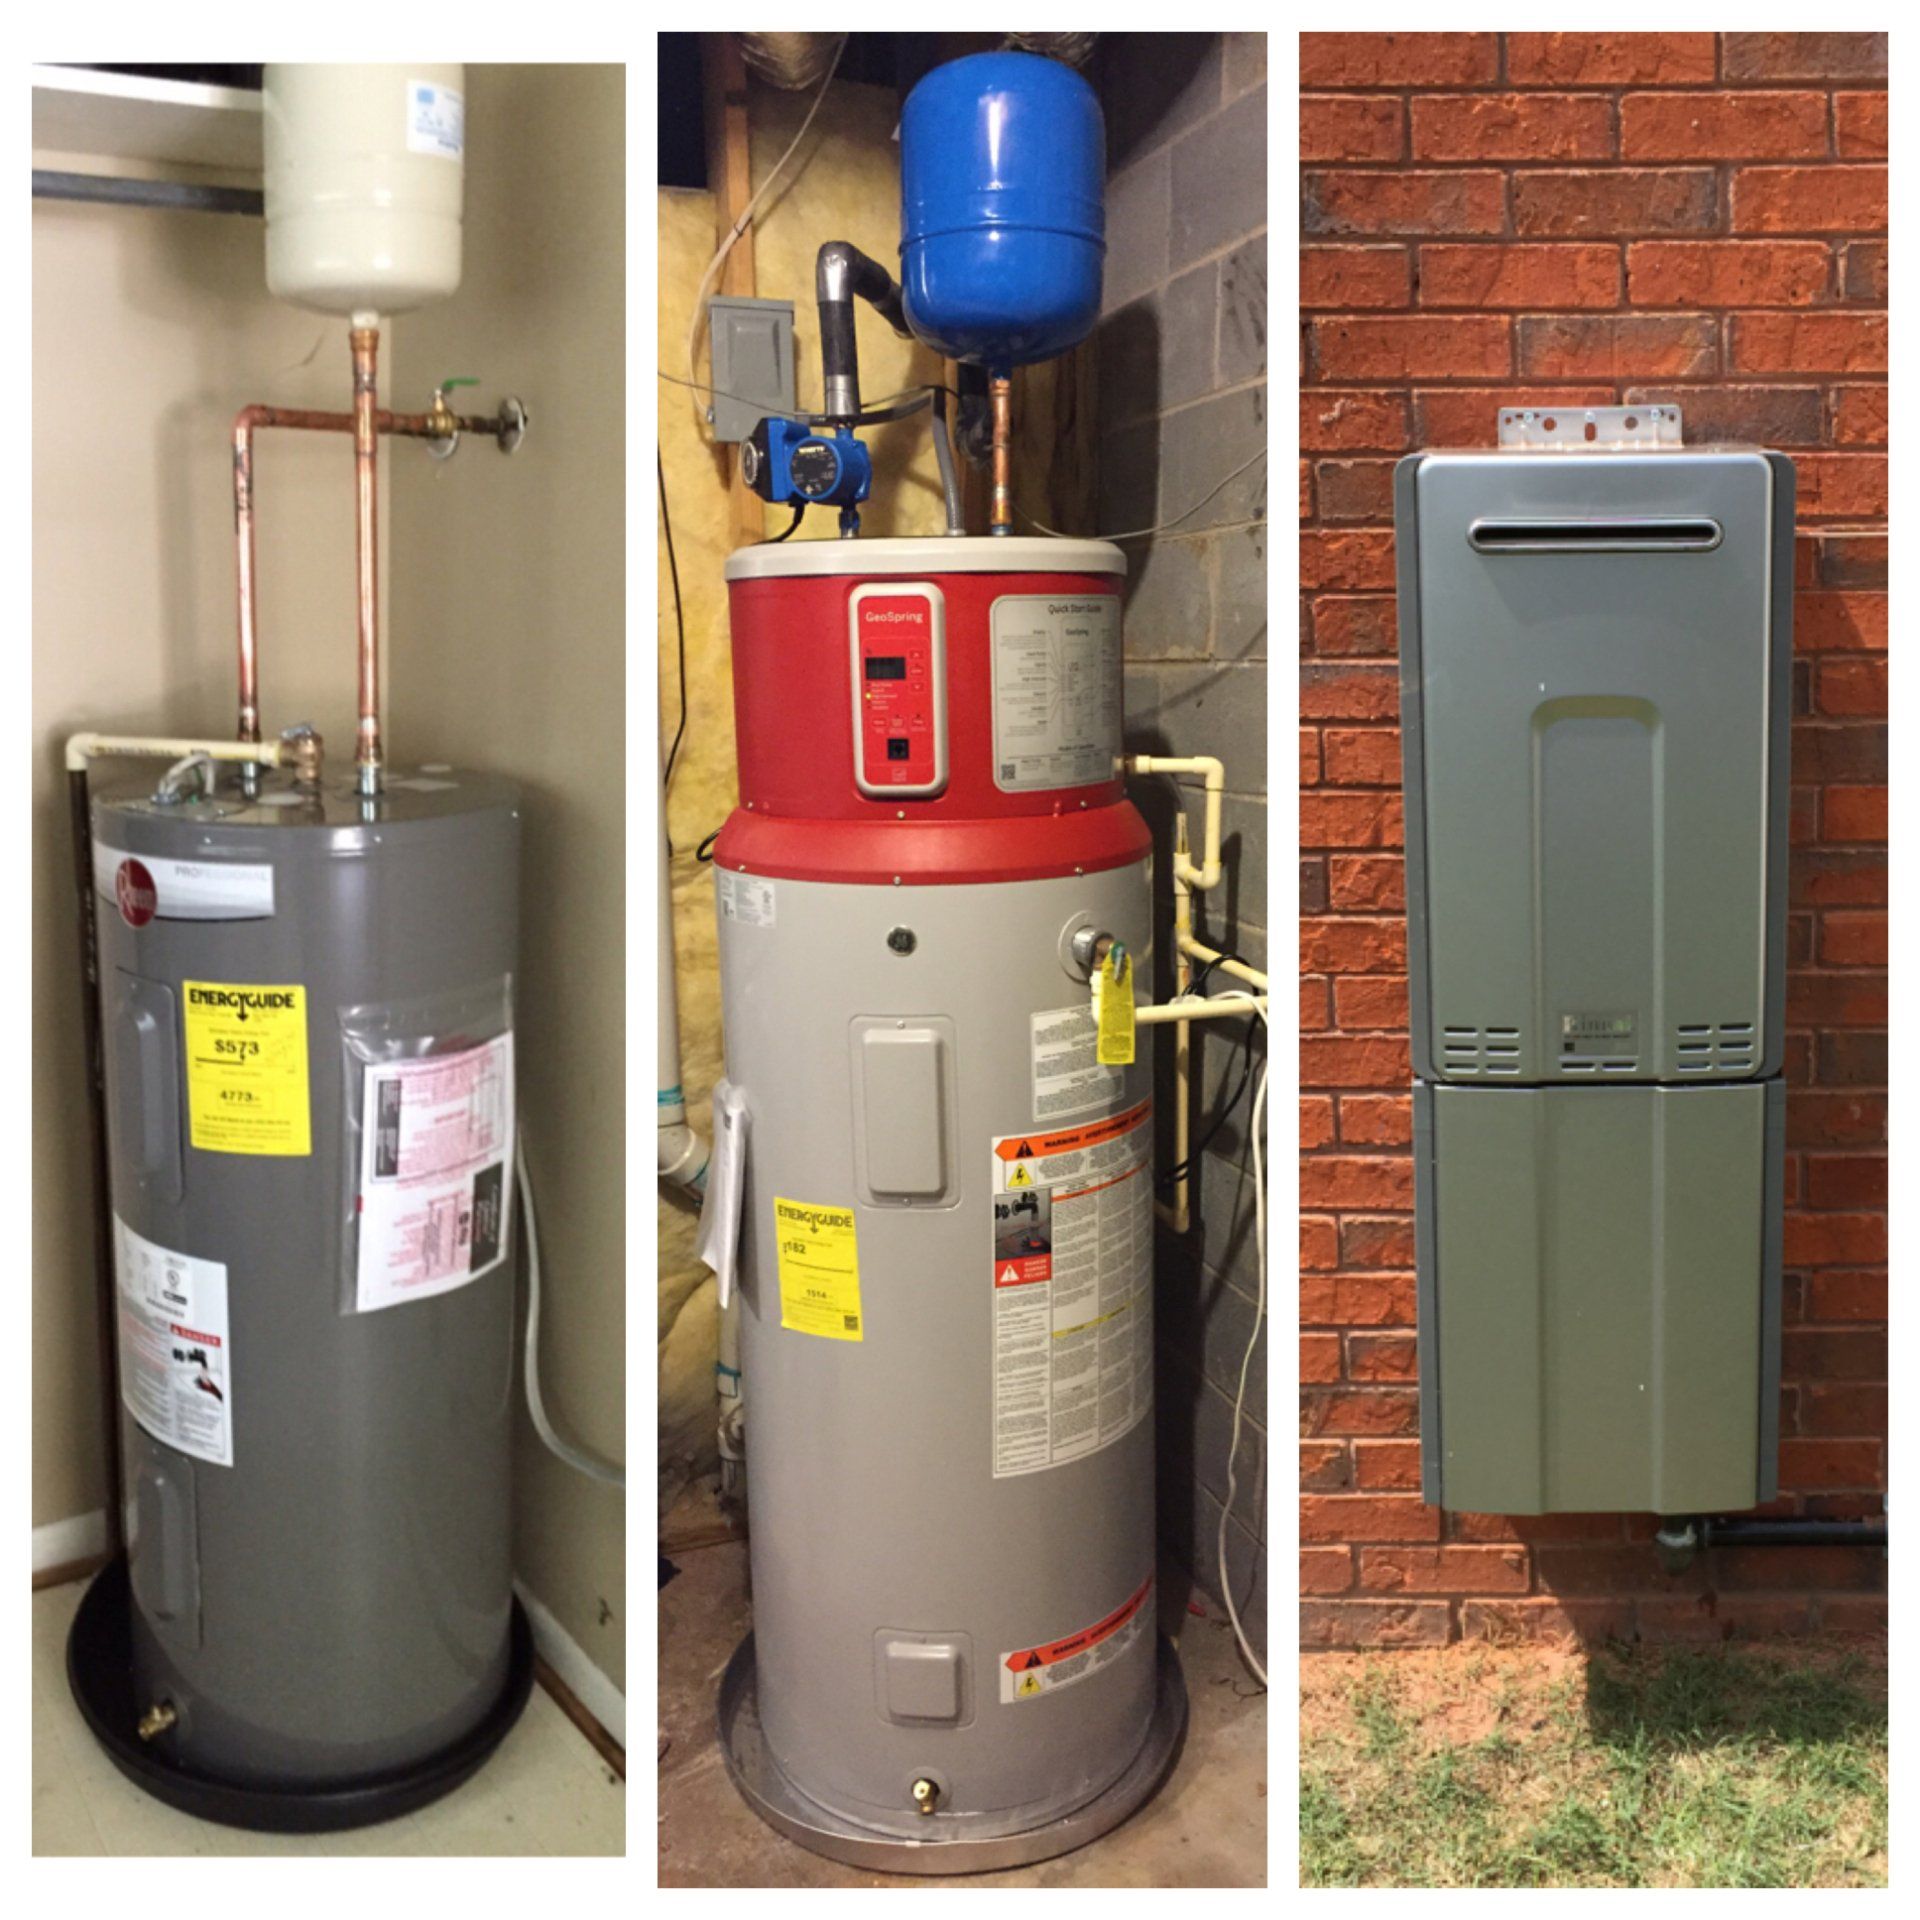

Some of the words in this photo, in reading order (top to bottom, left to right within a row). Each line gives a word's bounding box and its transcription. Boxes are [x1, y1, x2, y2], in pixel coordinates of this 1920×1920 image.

[1047, 604, 1068, 615] Quick
[864, 610, 924, 624] GeoSpring
[188, 988, 296, 1009] ENERGYGUIDE
[220, 1089, 254, 1102] 4773
[776, 1204, 854, 1229] ENERGYGUIDE
